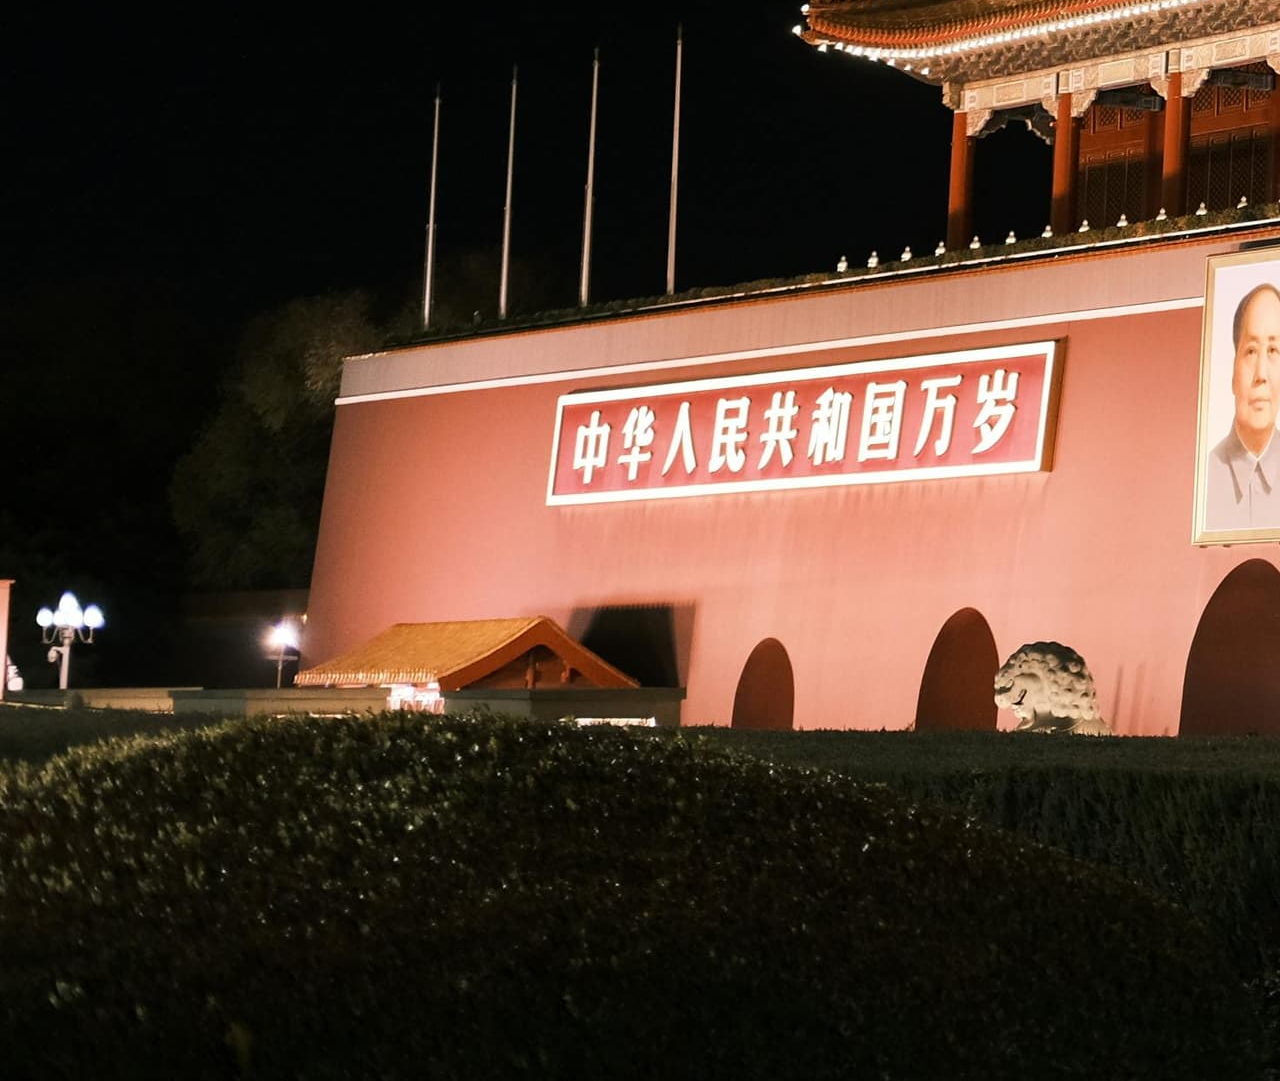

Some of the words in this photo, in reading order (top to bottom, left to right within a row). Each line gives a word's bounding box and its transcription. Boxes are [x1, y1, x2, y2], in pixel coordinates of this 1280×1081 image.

[572, 369, 1018, 484] 中华人民共和国万岁
